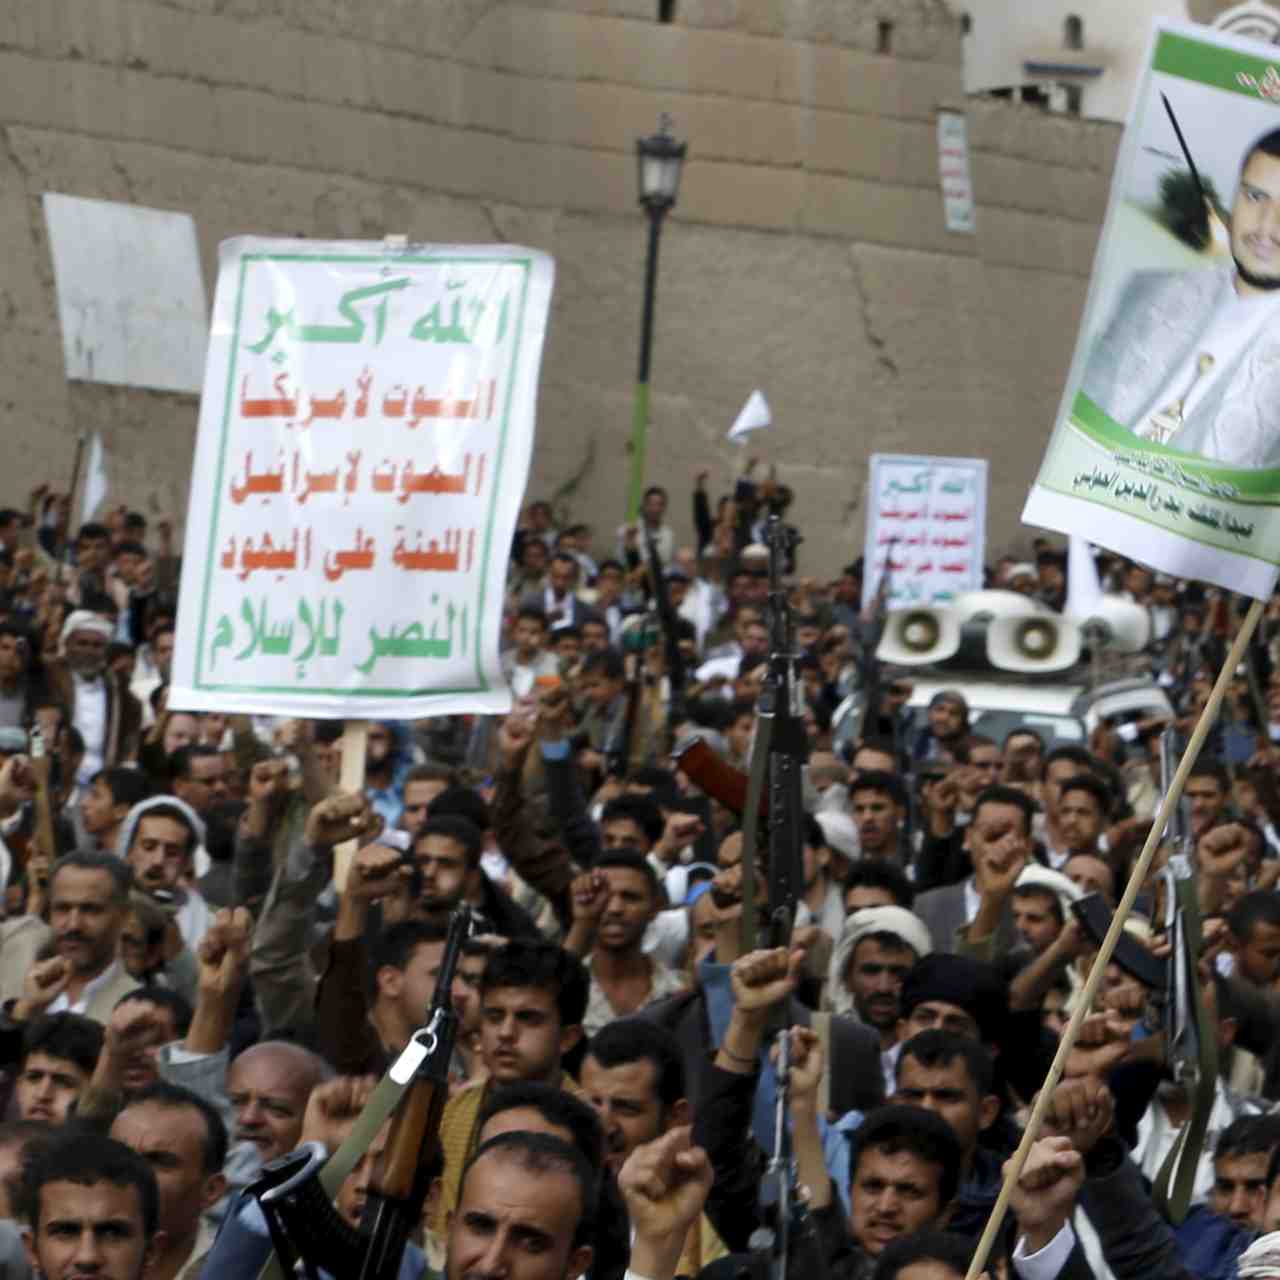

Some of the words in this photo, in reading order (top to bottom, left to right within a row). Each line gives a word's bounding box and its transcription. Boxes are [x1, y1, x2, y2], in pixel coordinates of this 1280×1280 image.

[409, 277, 511, 346] الله
[382, 378, 497, 428] الموت
[371, 450, 485, 505] الموت
[220, 526, 312, 583] اليهود
[323, 525, 375, 582] على
[391, 524, 475, 573] اللعنة
[354, 591, 468, 675] النصر
